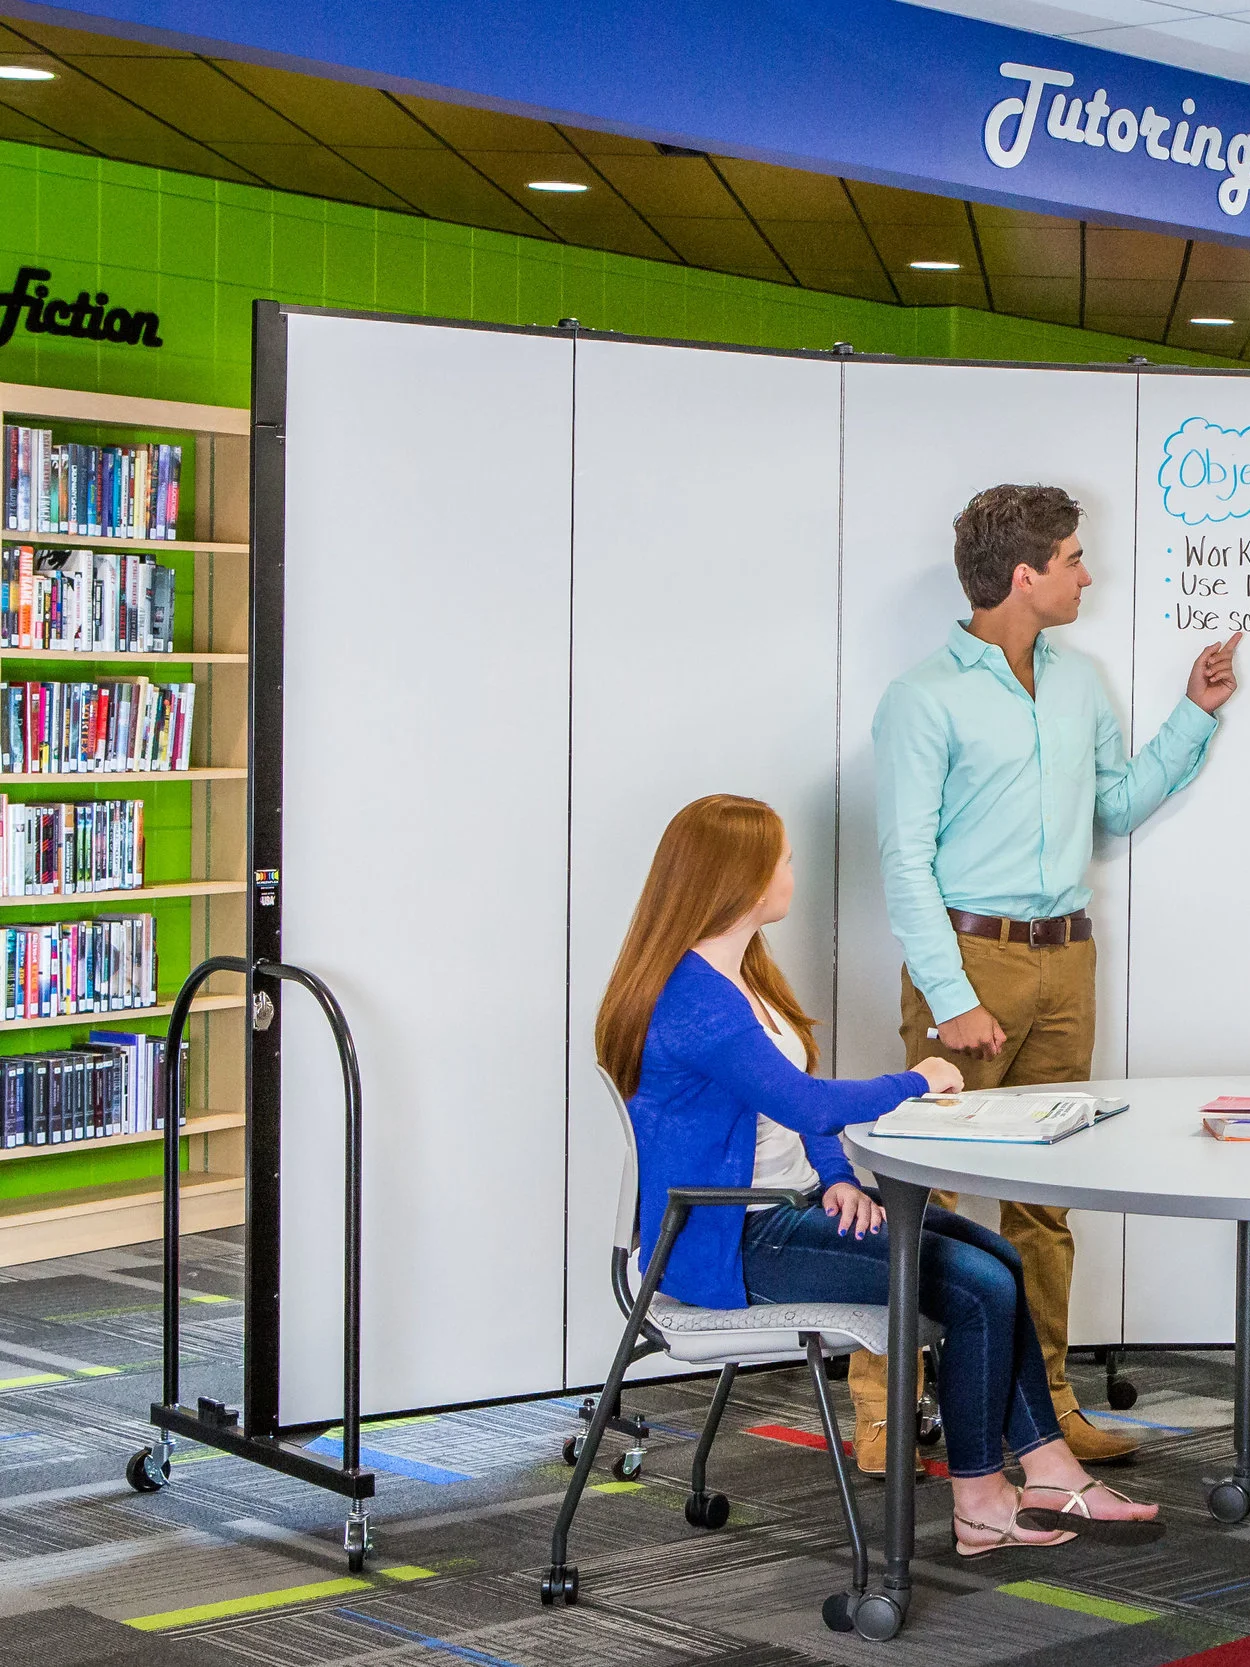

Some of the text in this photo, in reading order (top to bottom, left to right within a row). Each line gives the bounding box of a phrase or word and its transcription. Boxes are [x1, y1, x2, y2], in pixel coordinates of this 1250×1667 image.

[0, 266, 163, 347] Fiction
[21, 552, 32, 605] AIRFRAME
[1181, 571, 1226, 597] Use
[1177, 603, 1219, 630] Use
[81, 704, 89, 753] VORTEX
